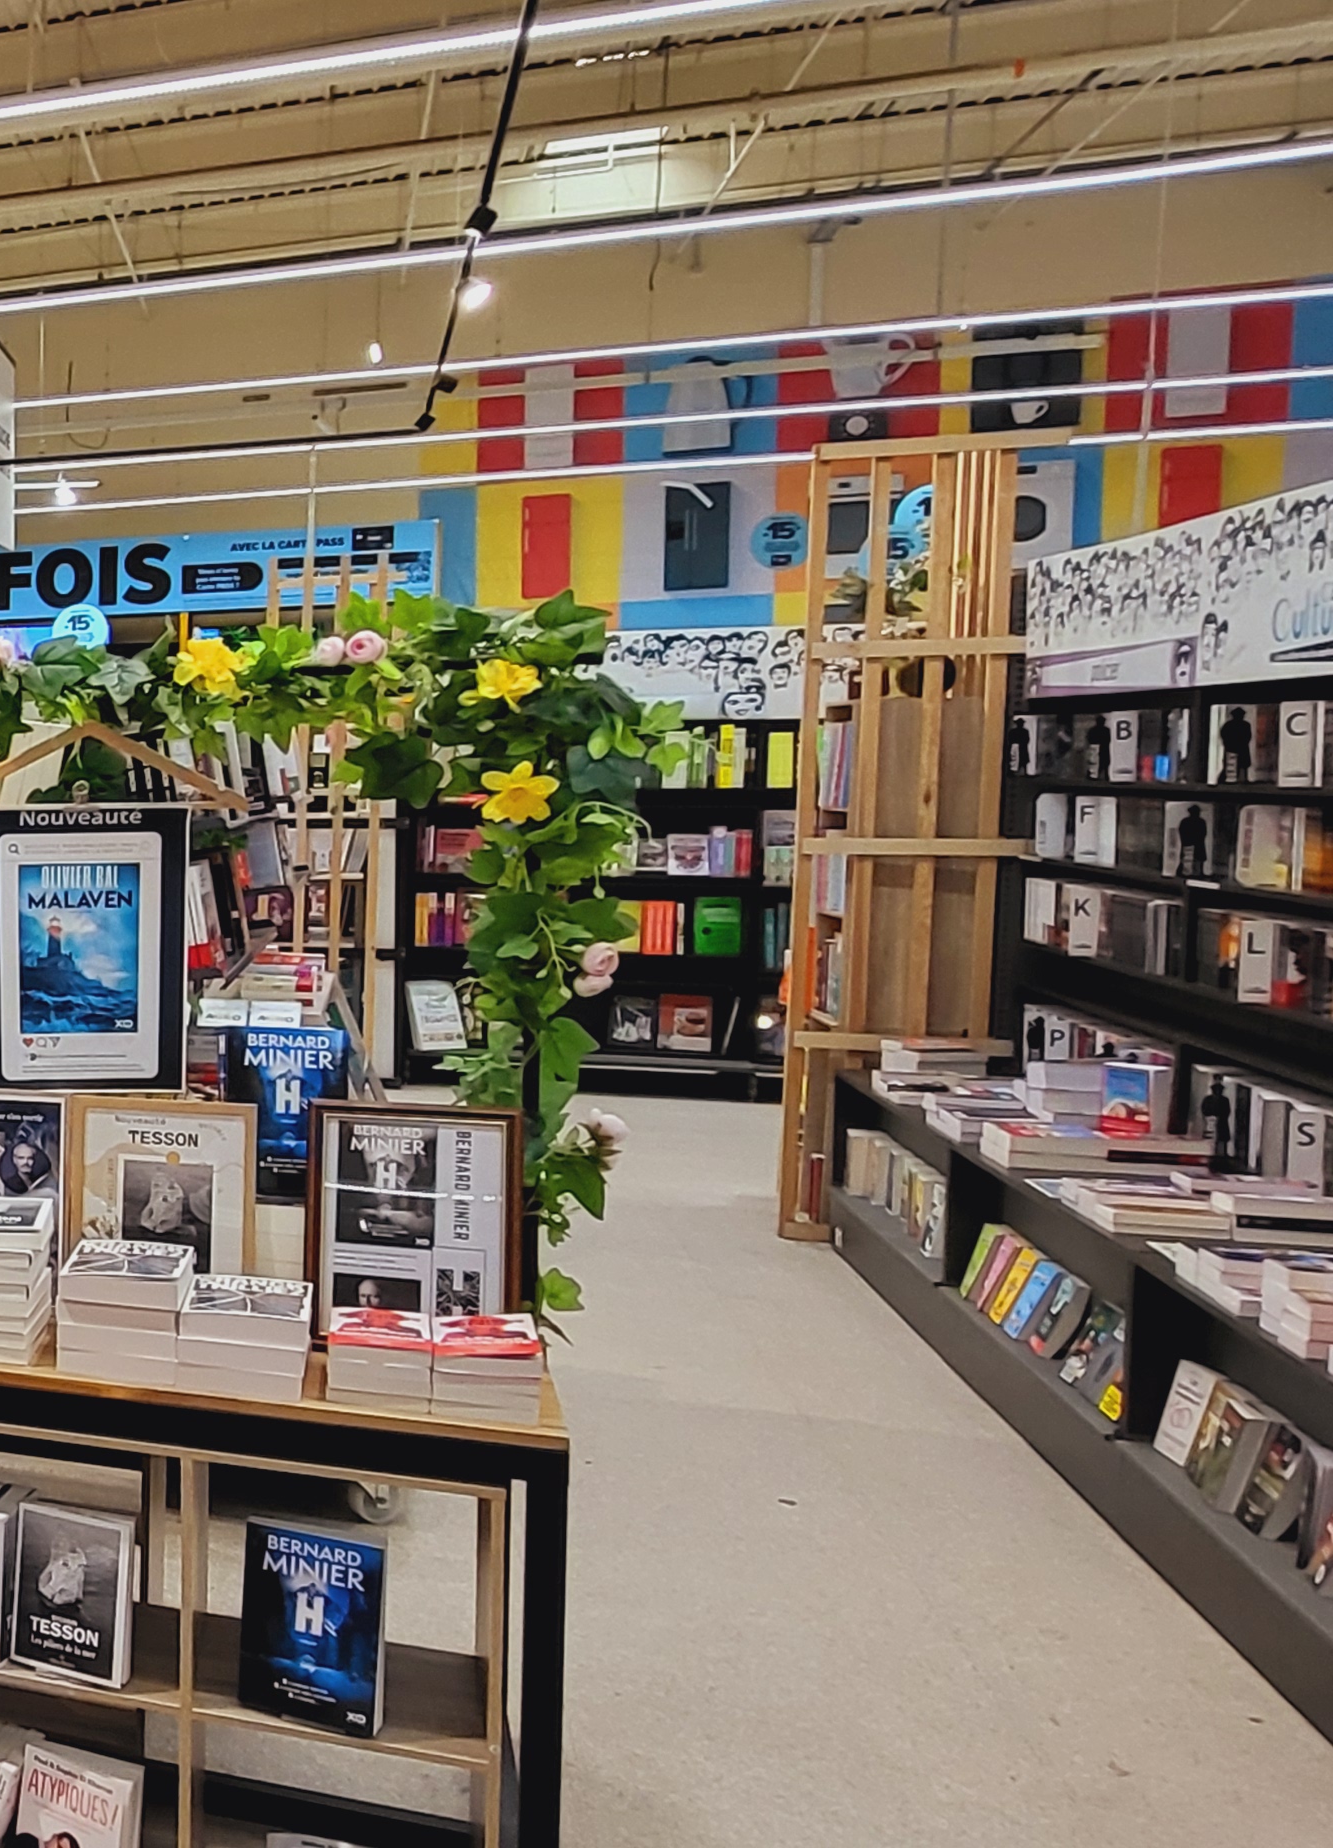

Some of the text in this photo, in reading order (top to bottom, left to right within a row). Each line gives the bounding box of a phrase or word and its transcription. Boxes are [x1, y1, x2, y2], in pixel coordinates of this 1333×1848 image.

[230, 537, 345, 552] AVEC LA CART PASS
[1272, 588, 1333, 642] Cultu
[1116, 719, 1132, 740] B
[1285, 712, 1309, 737] C
[1080, 805, 1096, 823] F
[41, 865, 119, 889] OLIVIER BAL
[27, 890, 133, 911] MALAVEN
[1074, 898, 1091, 917] K
[1246, 931, 1267, 955] L
[247, 1033, 330, 1051] BERNARD
[1049, 1028, 1066, 1047] P
[243, 1048, 334, 1070] MINIER
[274, 1076, 301, 1114] H
[128, 1130, 199, 1148] TESSON
[353, 1124, 423, 1138] BERNARD
[1296, 1121, 1317, 1147] S
[349, 1137, 427, 1156] MINIER
[454, 1130, 472, 1191] BERNARD
[374, 1160, 398, 1189] H
[453, 1194, 470, 1241] MINIER
[267, 1534, 362, 1567] BERNARD
[262, 1550, 365, 1592] MINIER
[294, 1590, 325, 1637] H
[29, 1614, 100, 1648] TESSON
